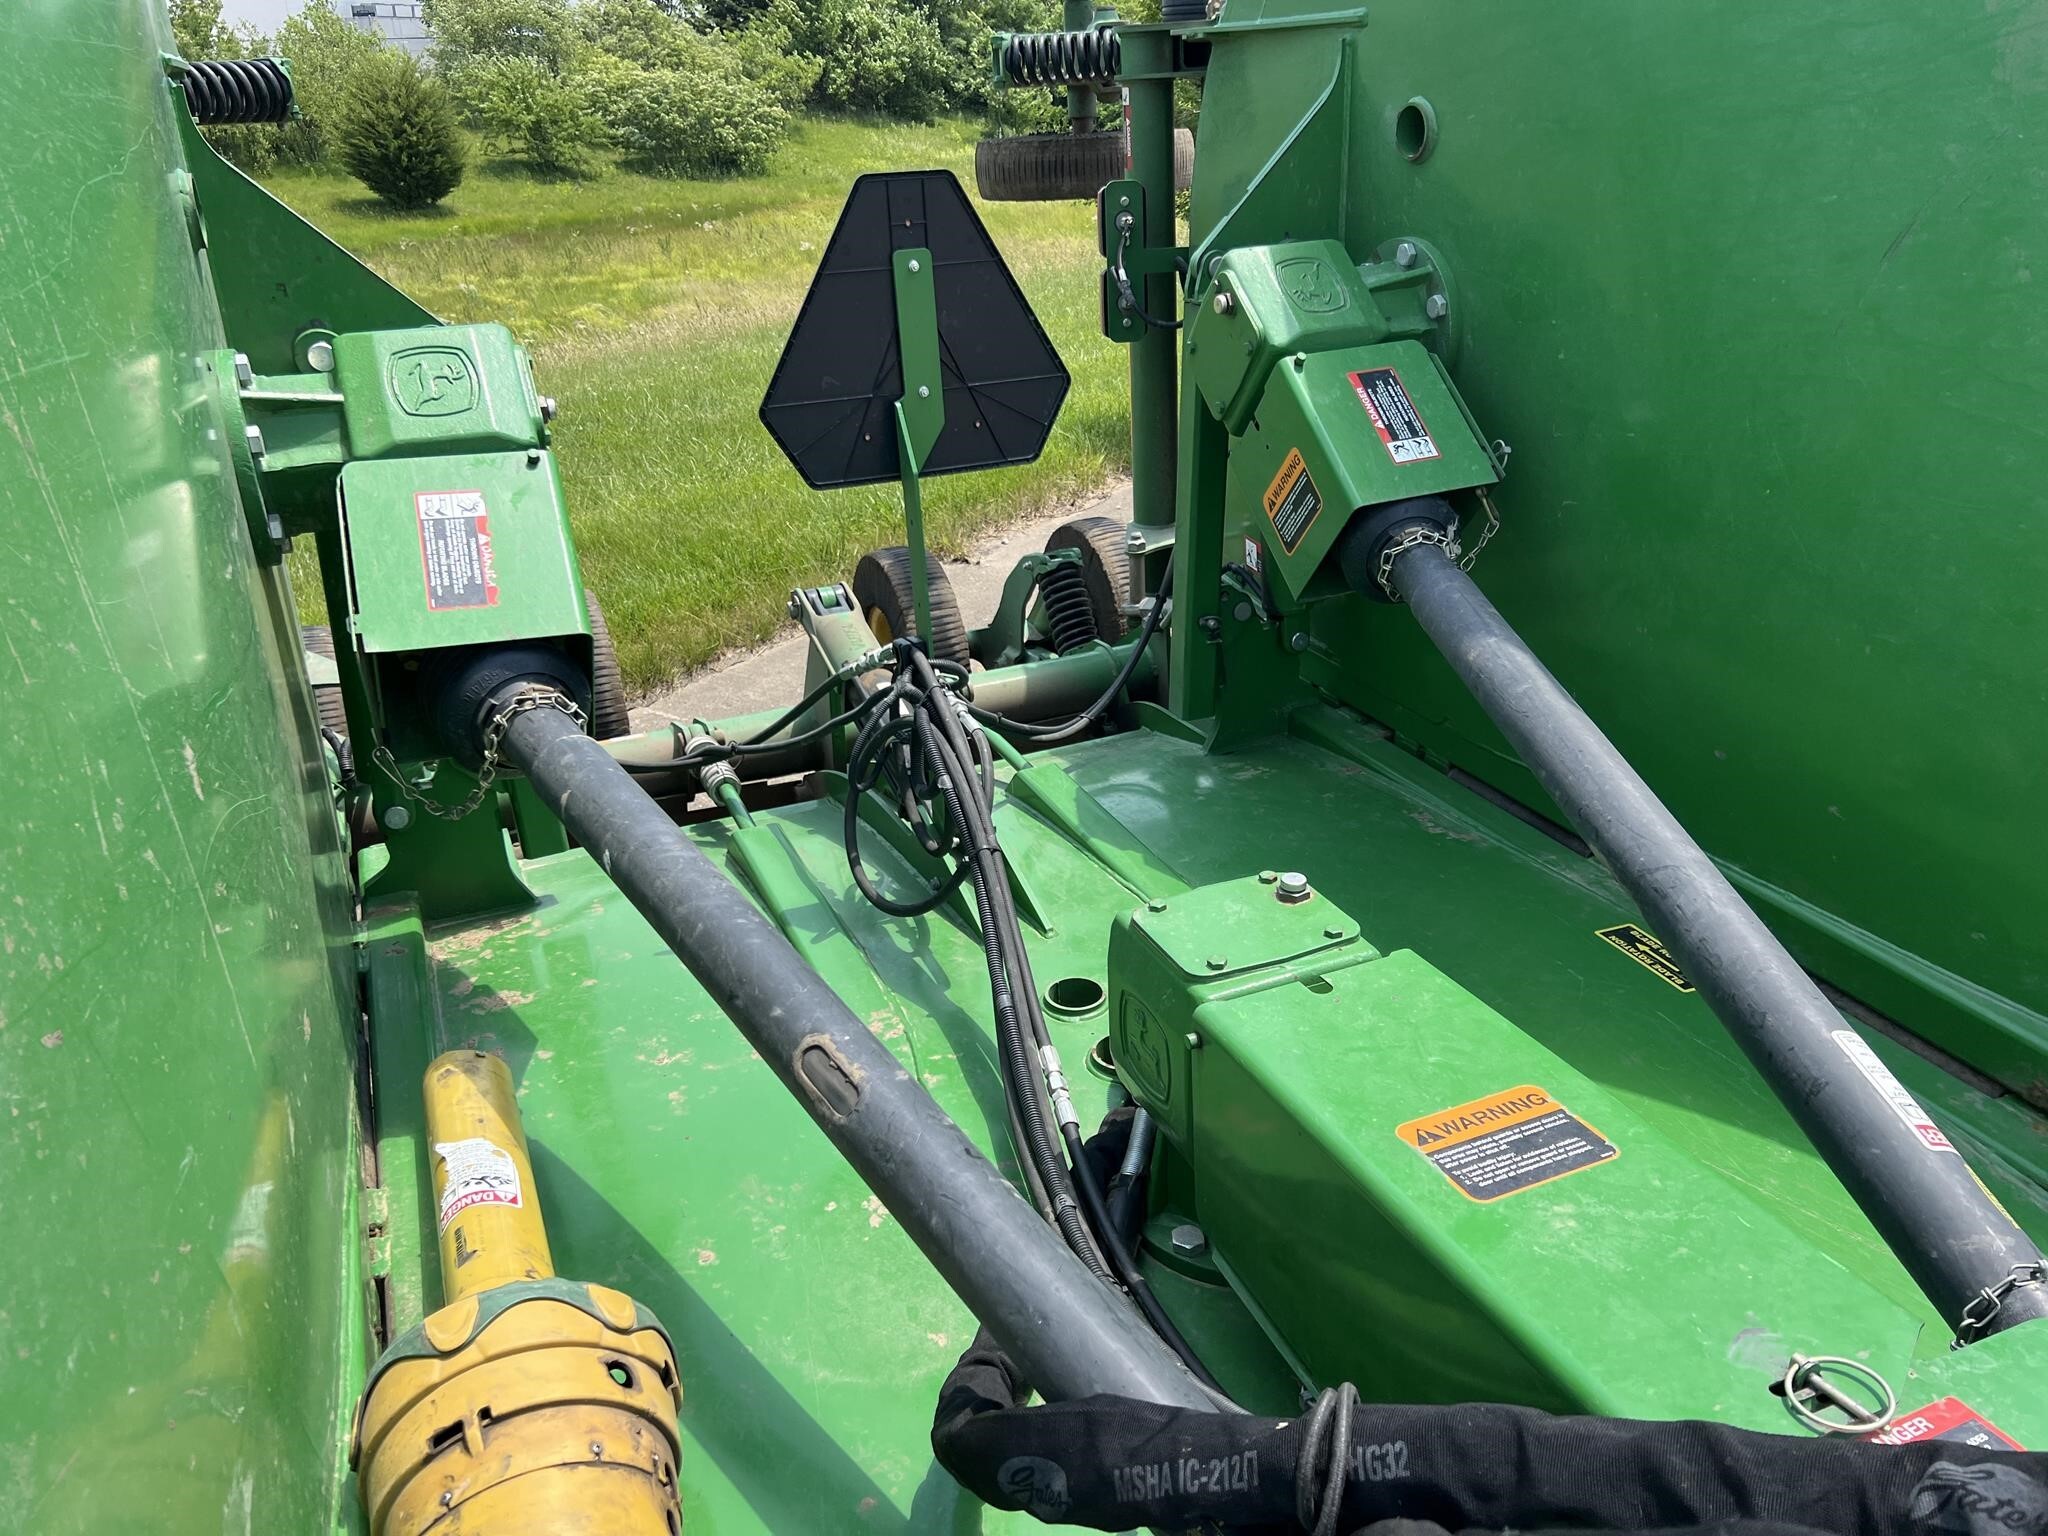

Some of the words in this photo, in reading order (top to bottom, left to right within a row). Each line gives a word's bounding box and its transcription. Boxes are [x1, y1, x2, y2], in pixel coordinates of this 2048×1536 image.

[1357, 387, 1380, 420] DANGER
[1272, 454, 1301, 502] WARNING
[1608, 935, 1654, 964] ROTATION
[1630, 930, 1661, 949] BLADE
[1652, 963, 1684, 984] BLADE
[1434, 1093, 1549, 1134] WARNING
[1113, 1461, 1174, 1504] MSHA
